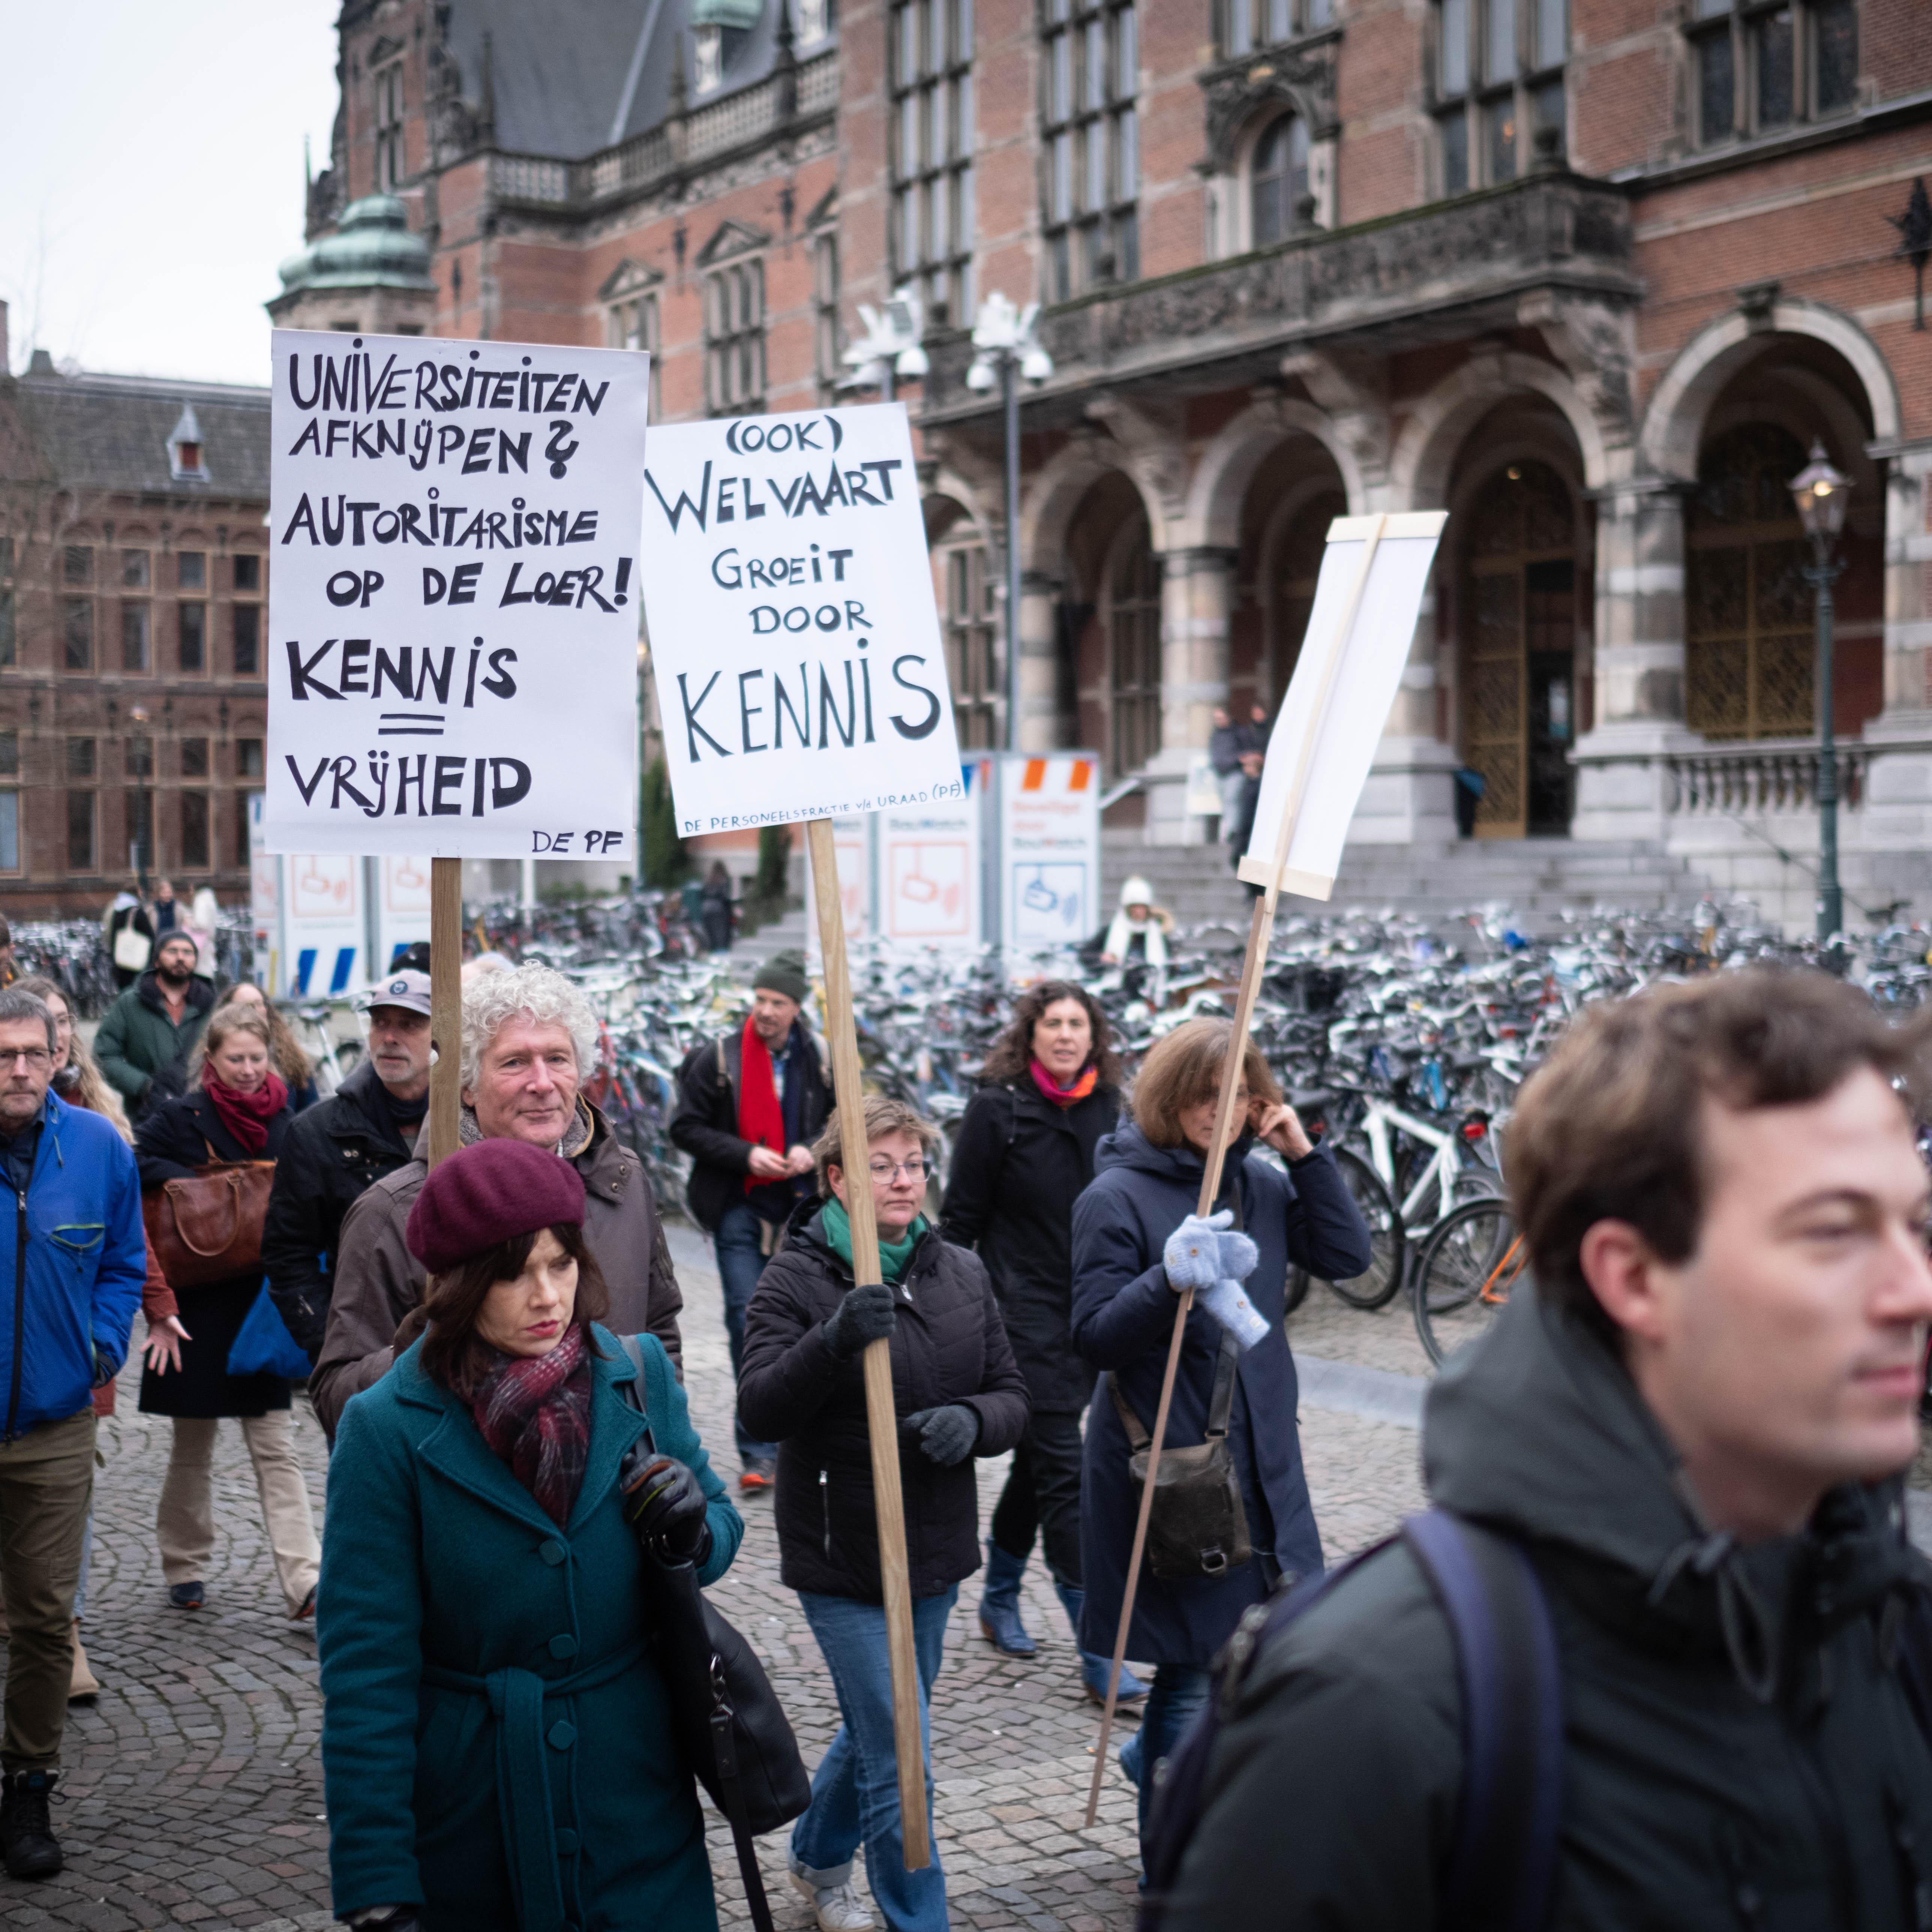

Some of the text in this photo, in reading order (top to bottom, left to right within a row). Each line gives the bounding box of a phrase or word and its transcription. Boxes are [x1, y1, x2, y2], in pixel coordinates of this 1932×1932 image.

[726, 415, 843, 455] (OOK)
[644, 459, 902, 535] WELVAART
[327, 570, 384, 608] OP
[423, 562, 483, 605] DE
[749, 601, 872, 633] DOOR
[684, 819, 702, 833] DE
[877, 792, 927, 807] URAAD
[532, 830, 623, 853] DE PF
